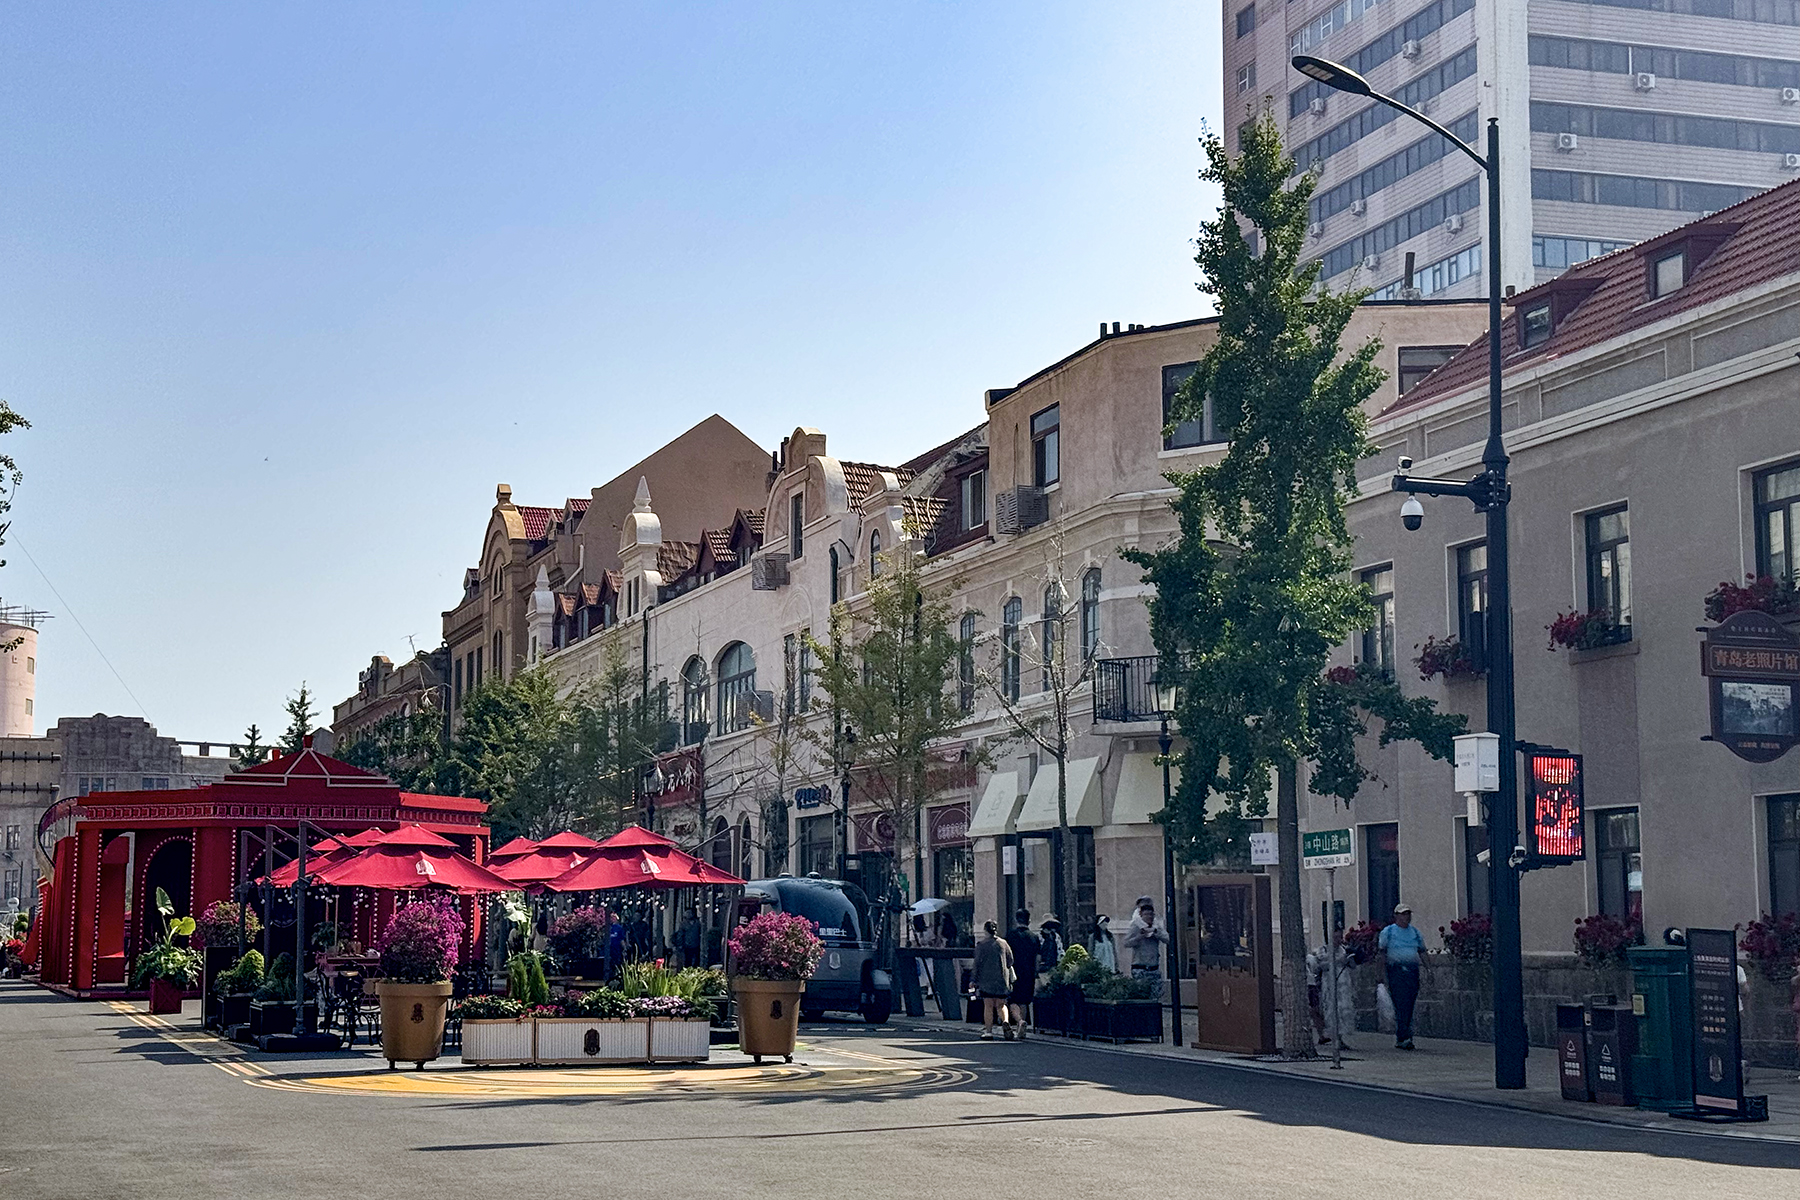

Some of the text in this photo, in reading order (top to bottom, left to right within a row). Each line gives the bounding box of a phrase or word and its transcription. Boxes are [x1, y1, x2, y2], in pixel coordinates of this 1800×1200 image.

[1714, 649, 1799, 670] 青岛老照片馆
[1313, 835, 1339, 852] 中山路
